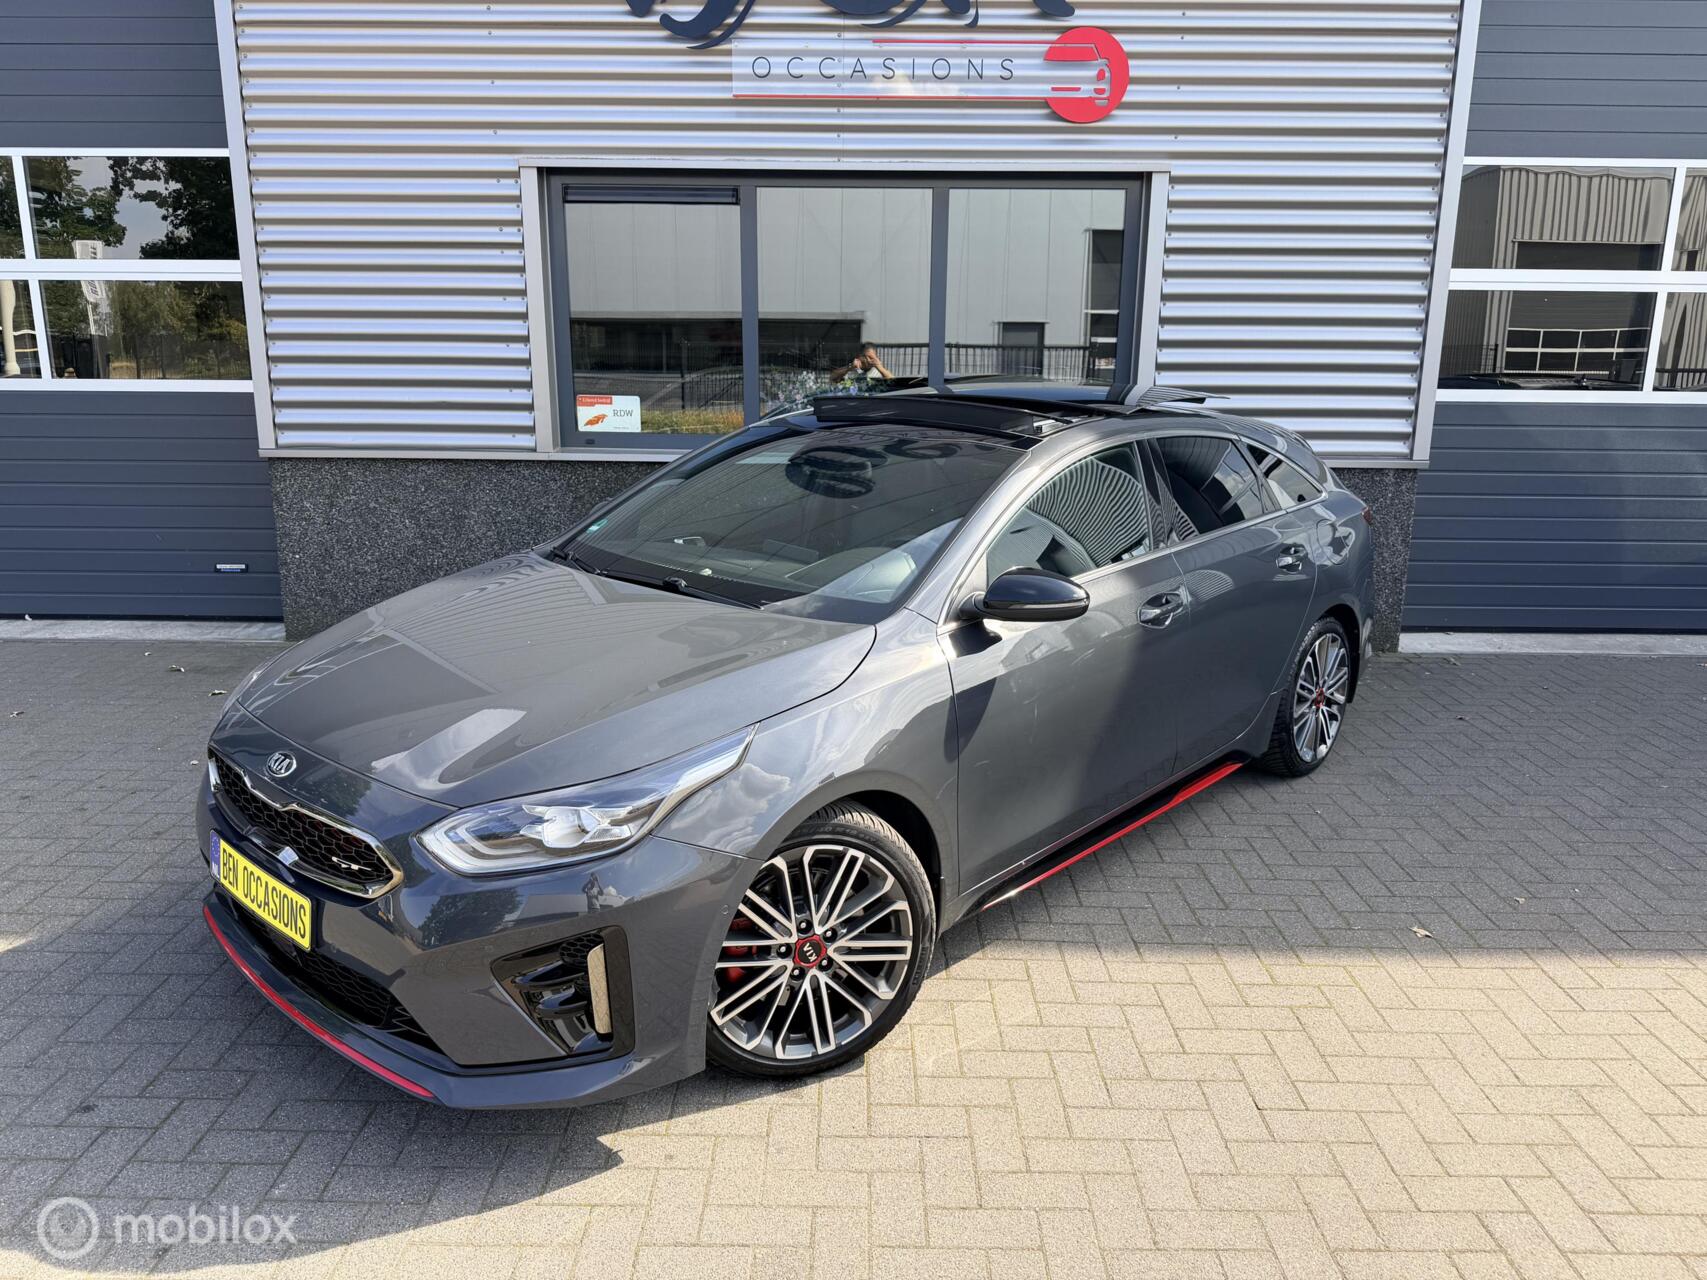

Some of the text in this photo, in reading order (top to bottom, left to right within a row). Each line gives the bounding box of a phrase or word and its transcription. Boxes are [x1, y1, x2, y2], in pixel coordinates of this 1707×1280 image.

[751, 55, 1015, 82] OCCASIONS
[612, 408, 634, 418] RDW
[268, 752, 290, 774] KIA
[222, 847, 307, 940] BEN OCCASIONS
[803, 942, 818, 962] KIA
